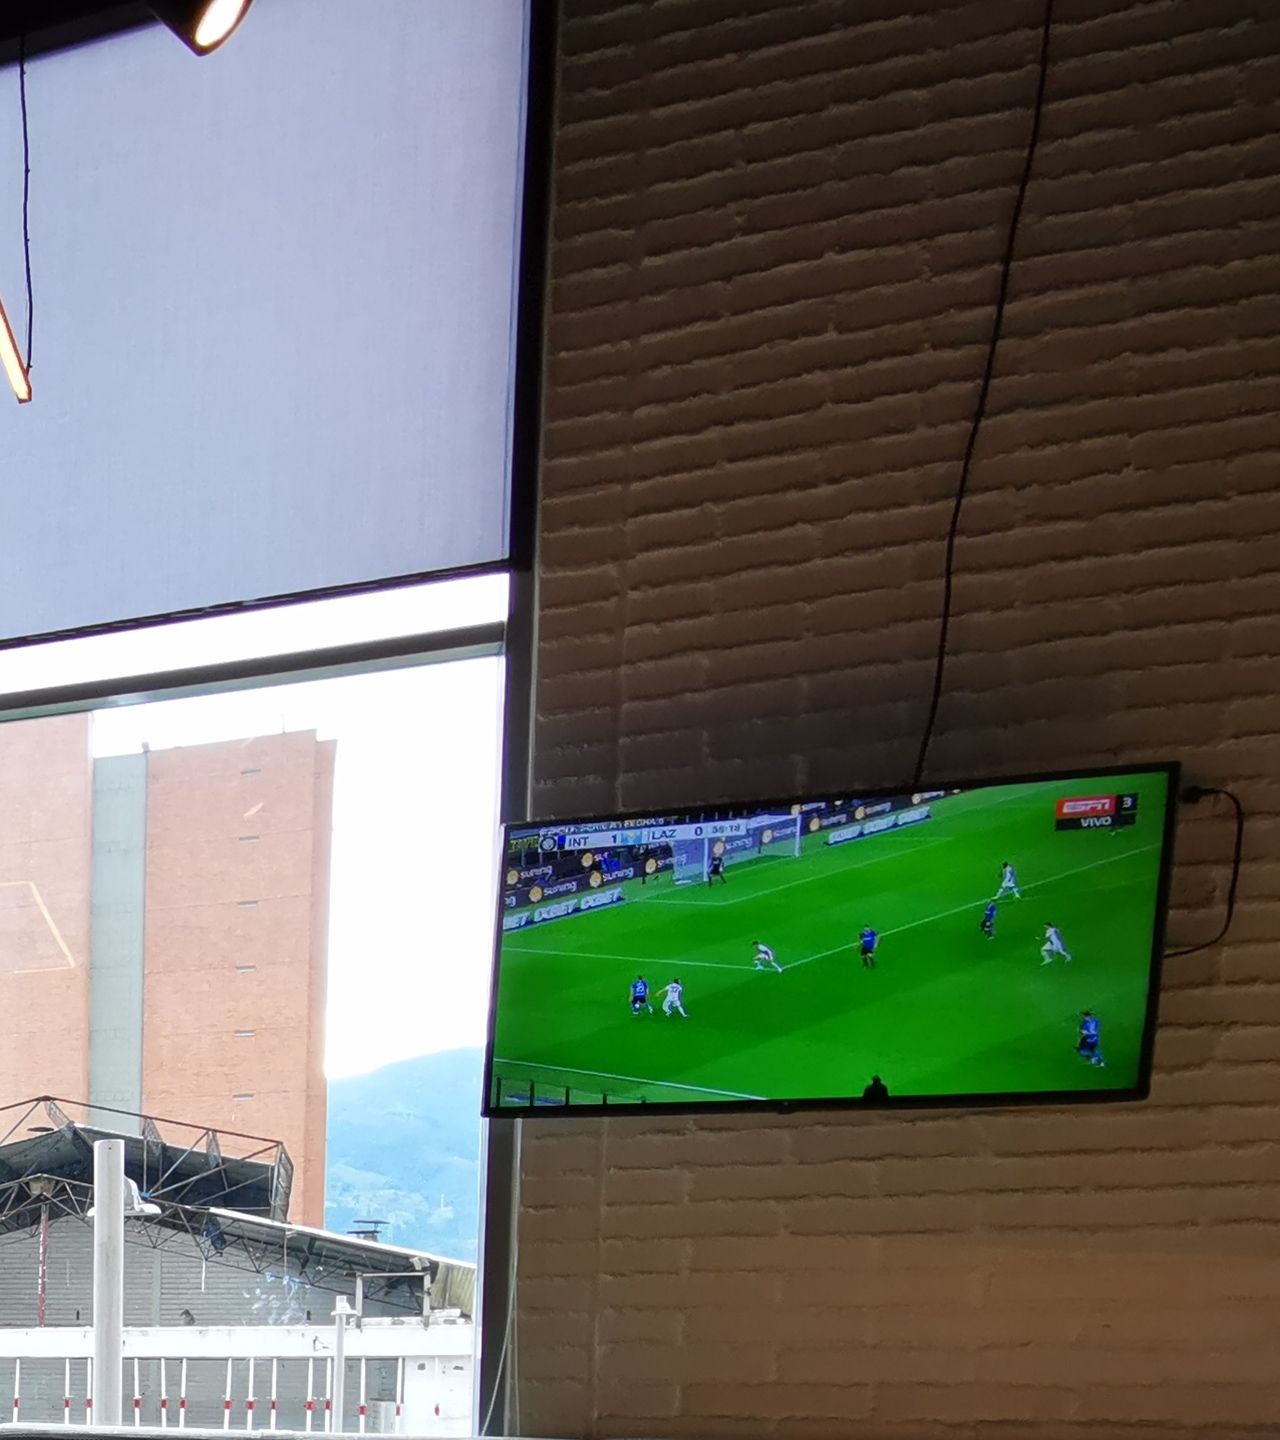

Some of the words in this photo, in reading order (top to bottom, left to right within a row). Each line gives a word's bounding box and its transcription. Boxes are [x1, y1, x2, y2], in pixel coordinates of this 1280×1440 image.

[1122, 796, 1133, 808] 3
[1081, 816, 1112, 828] VIVO
[568, 836, 590, 847] INT
[611, 834, 618, 844] 1
[651, 829, 677, 840] LAZ
[694, 826, 704, 837] 0
